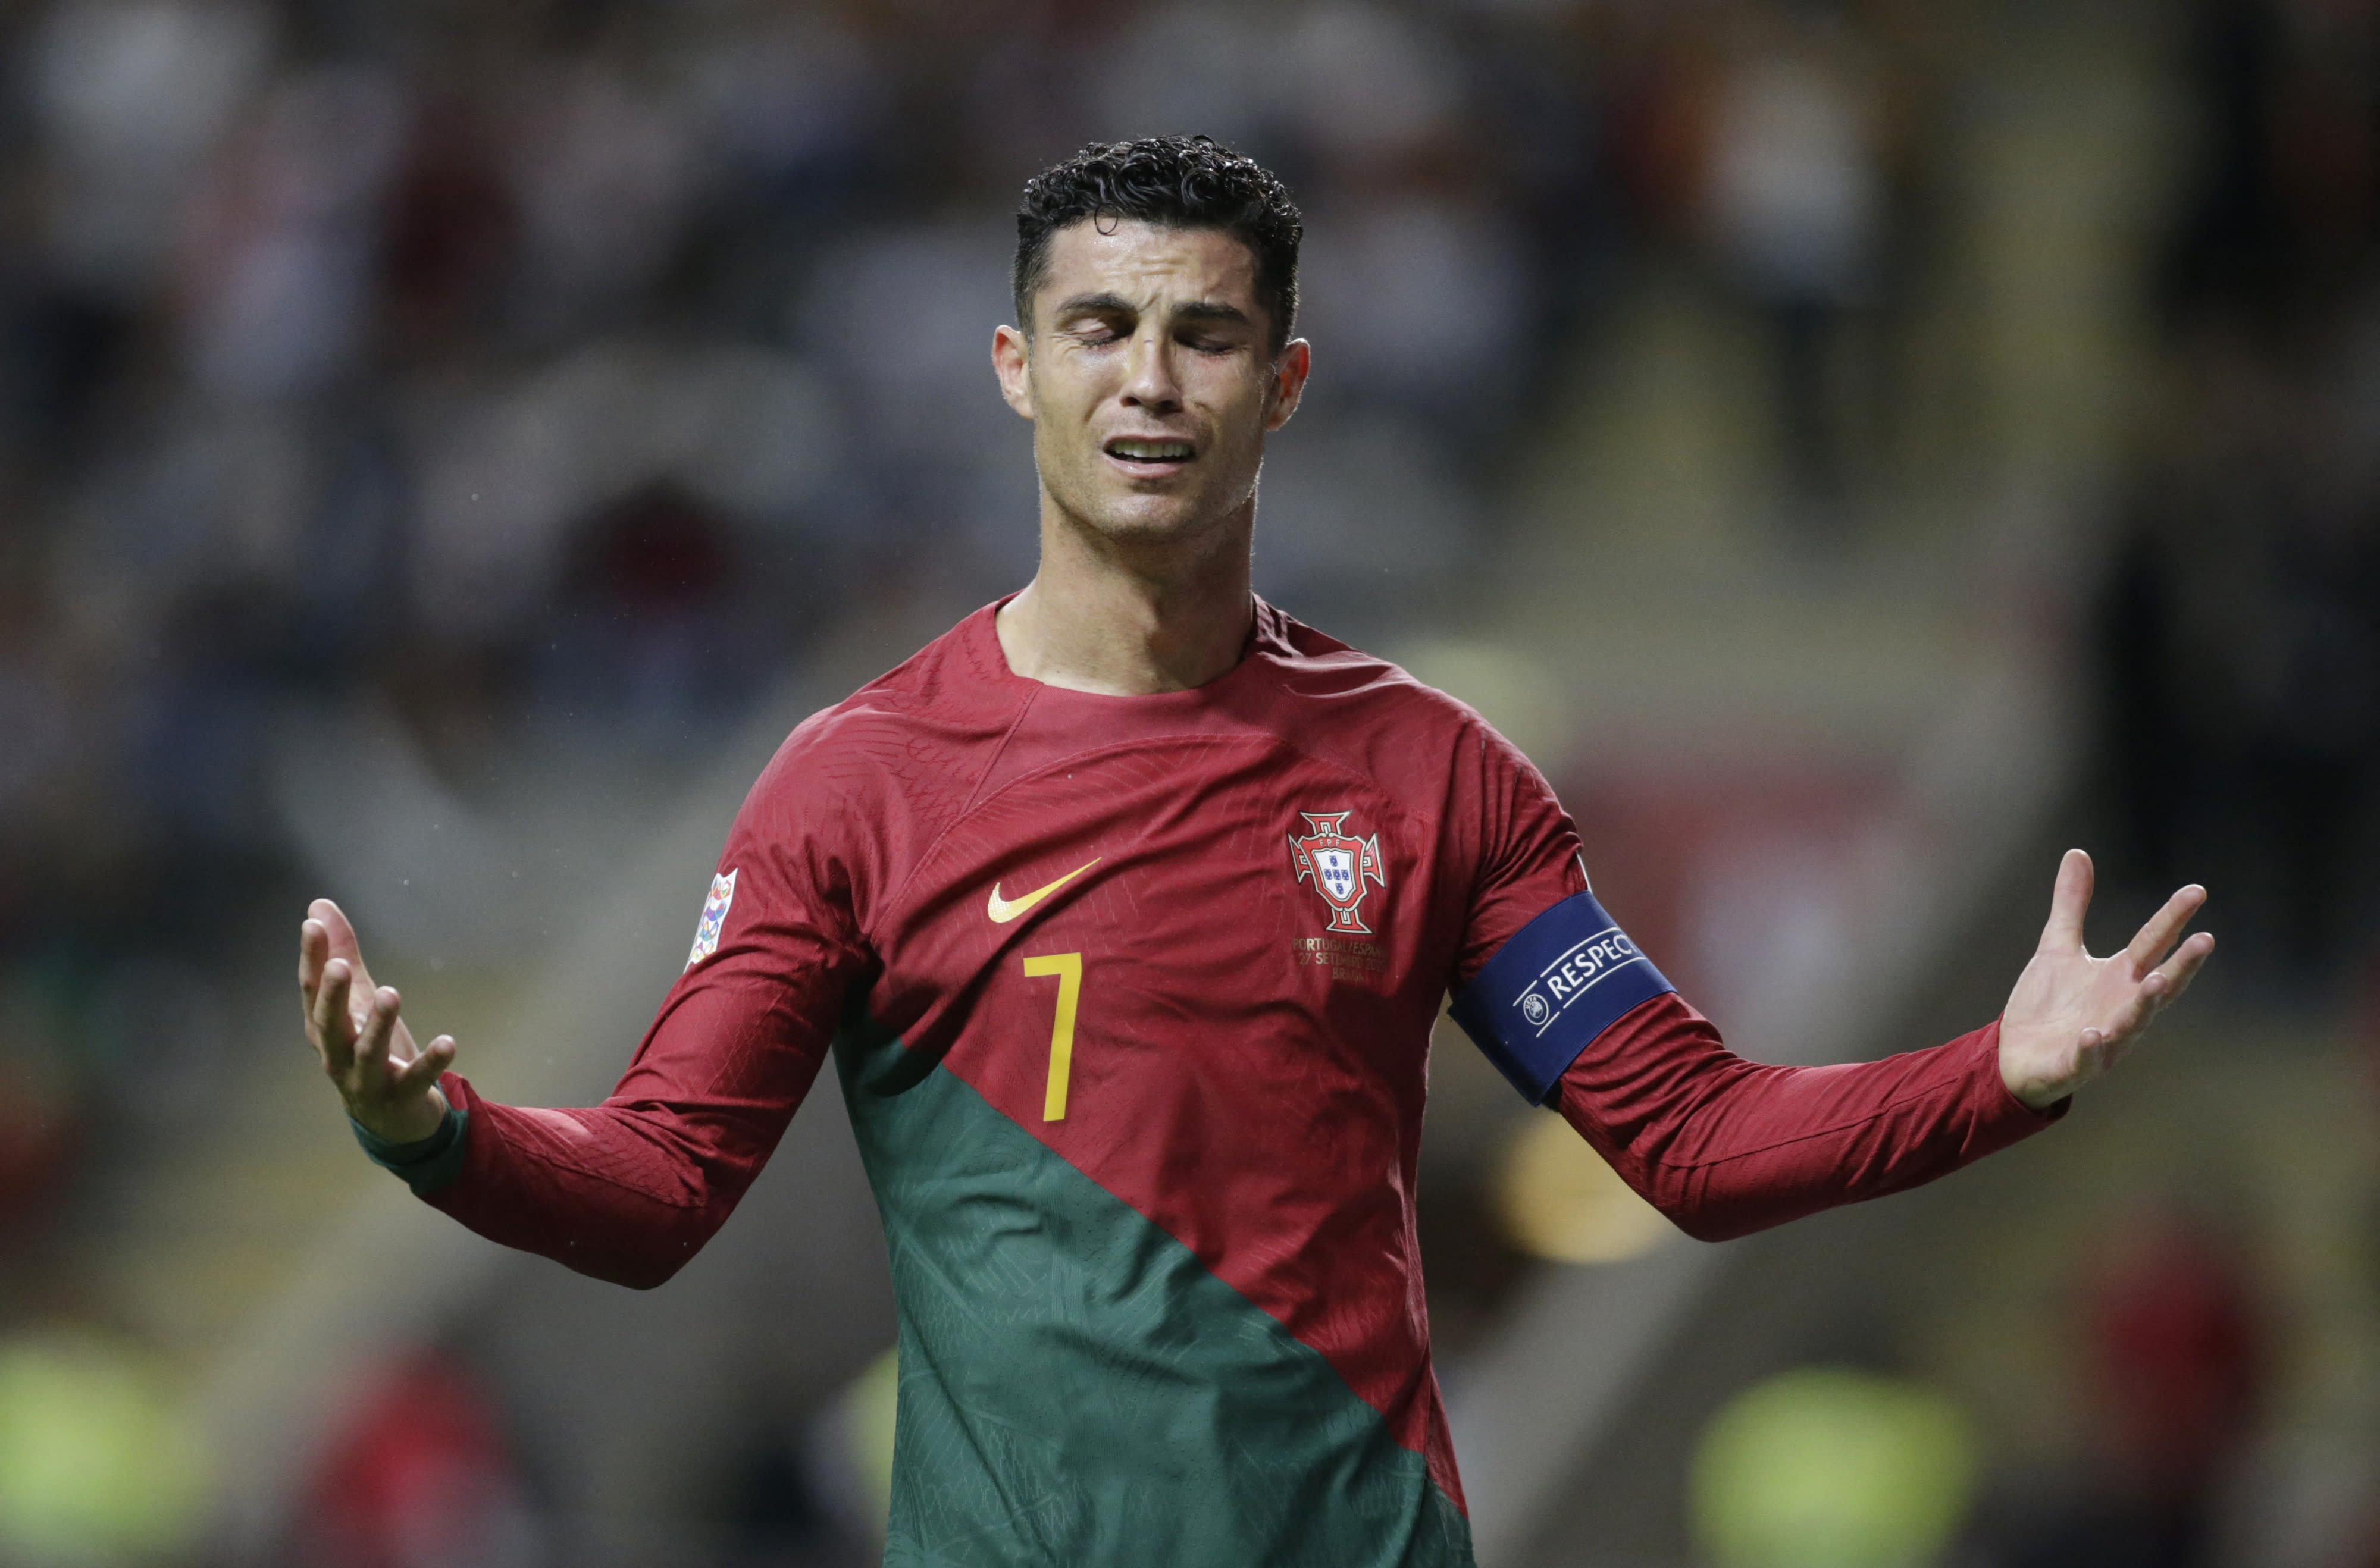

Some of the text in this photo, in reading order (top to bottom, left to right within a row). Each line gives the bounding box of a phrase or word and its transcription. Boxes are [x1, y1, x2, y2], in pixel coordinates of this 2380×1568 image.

[1299, 952, 1312, 965] 27
[1525, 996, 1537, 1009] UEFA
[1023, 952, 1082, 1121] 7
